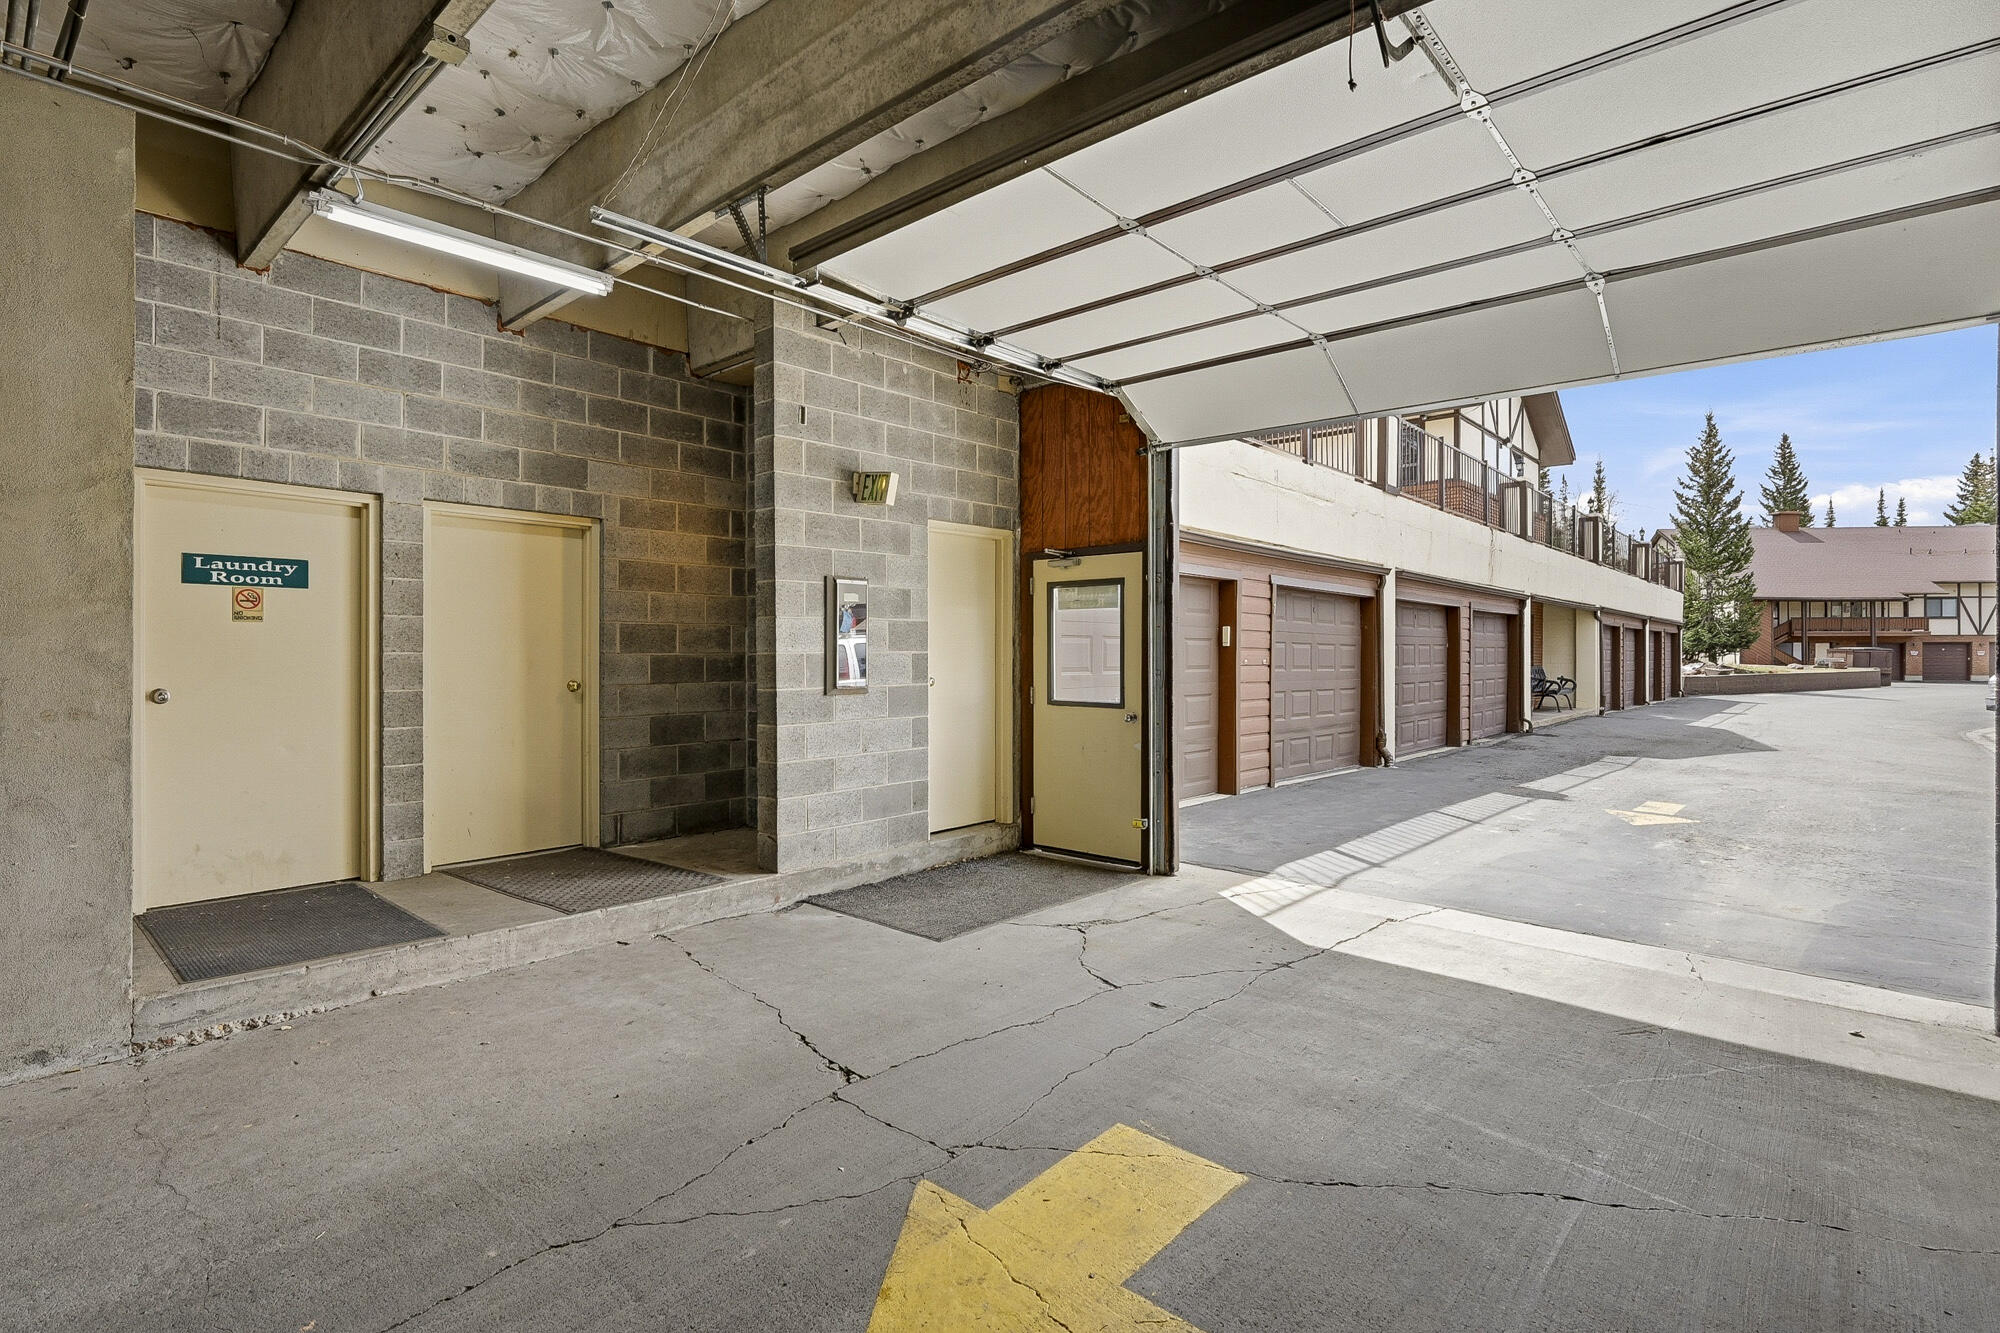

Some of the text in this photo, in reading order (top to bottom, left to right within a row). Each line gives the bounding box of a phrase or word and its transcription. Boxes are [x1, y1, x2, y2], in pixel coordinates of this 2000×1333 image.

[861, 474, 889, 501] EXIT
[193, 556, 299, 577] Laundry
[209, 570, 284, 586] Room
